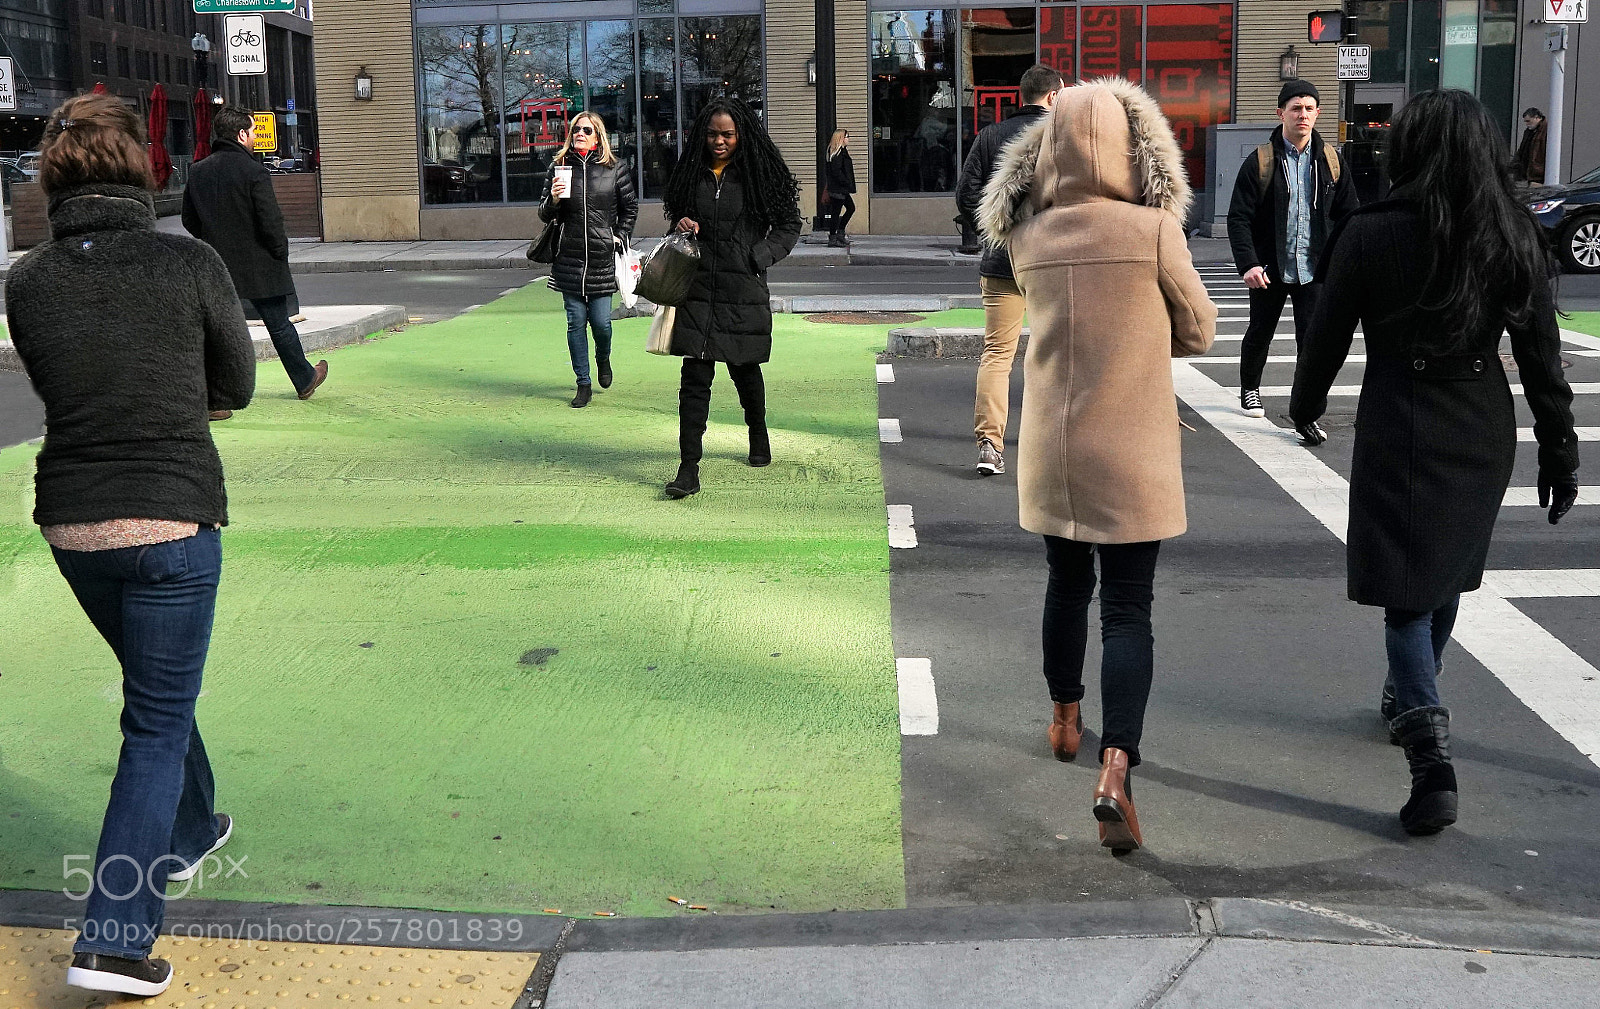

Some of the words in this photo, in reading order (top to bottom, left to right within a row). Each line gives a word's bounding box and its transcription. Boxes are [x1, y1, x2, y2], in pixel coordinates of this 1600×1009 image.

[1340, 48, 1368, 57] YIELD
[232, 55, 261, 63] SIGNAL
[1347, 69, 1368, 77] TURNS
